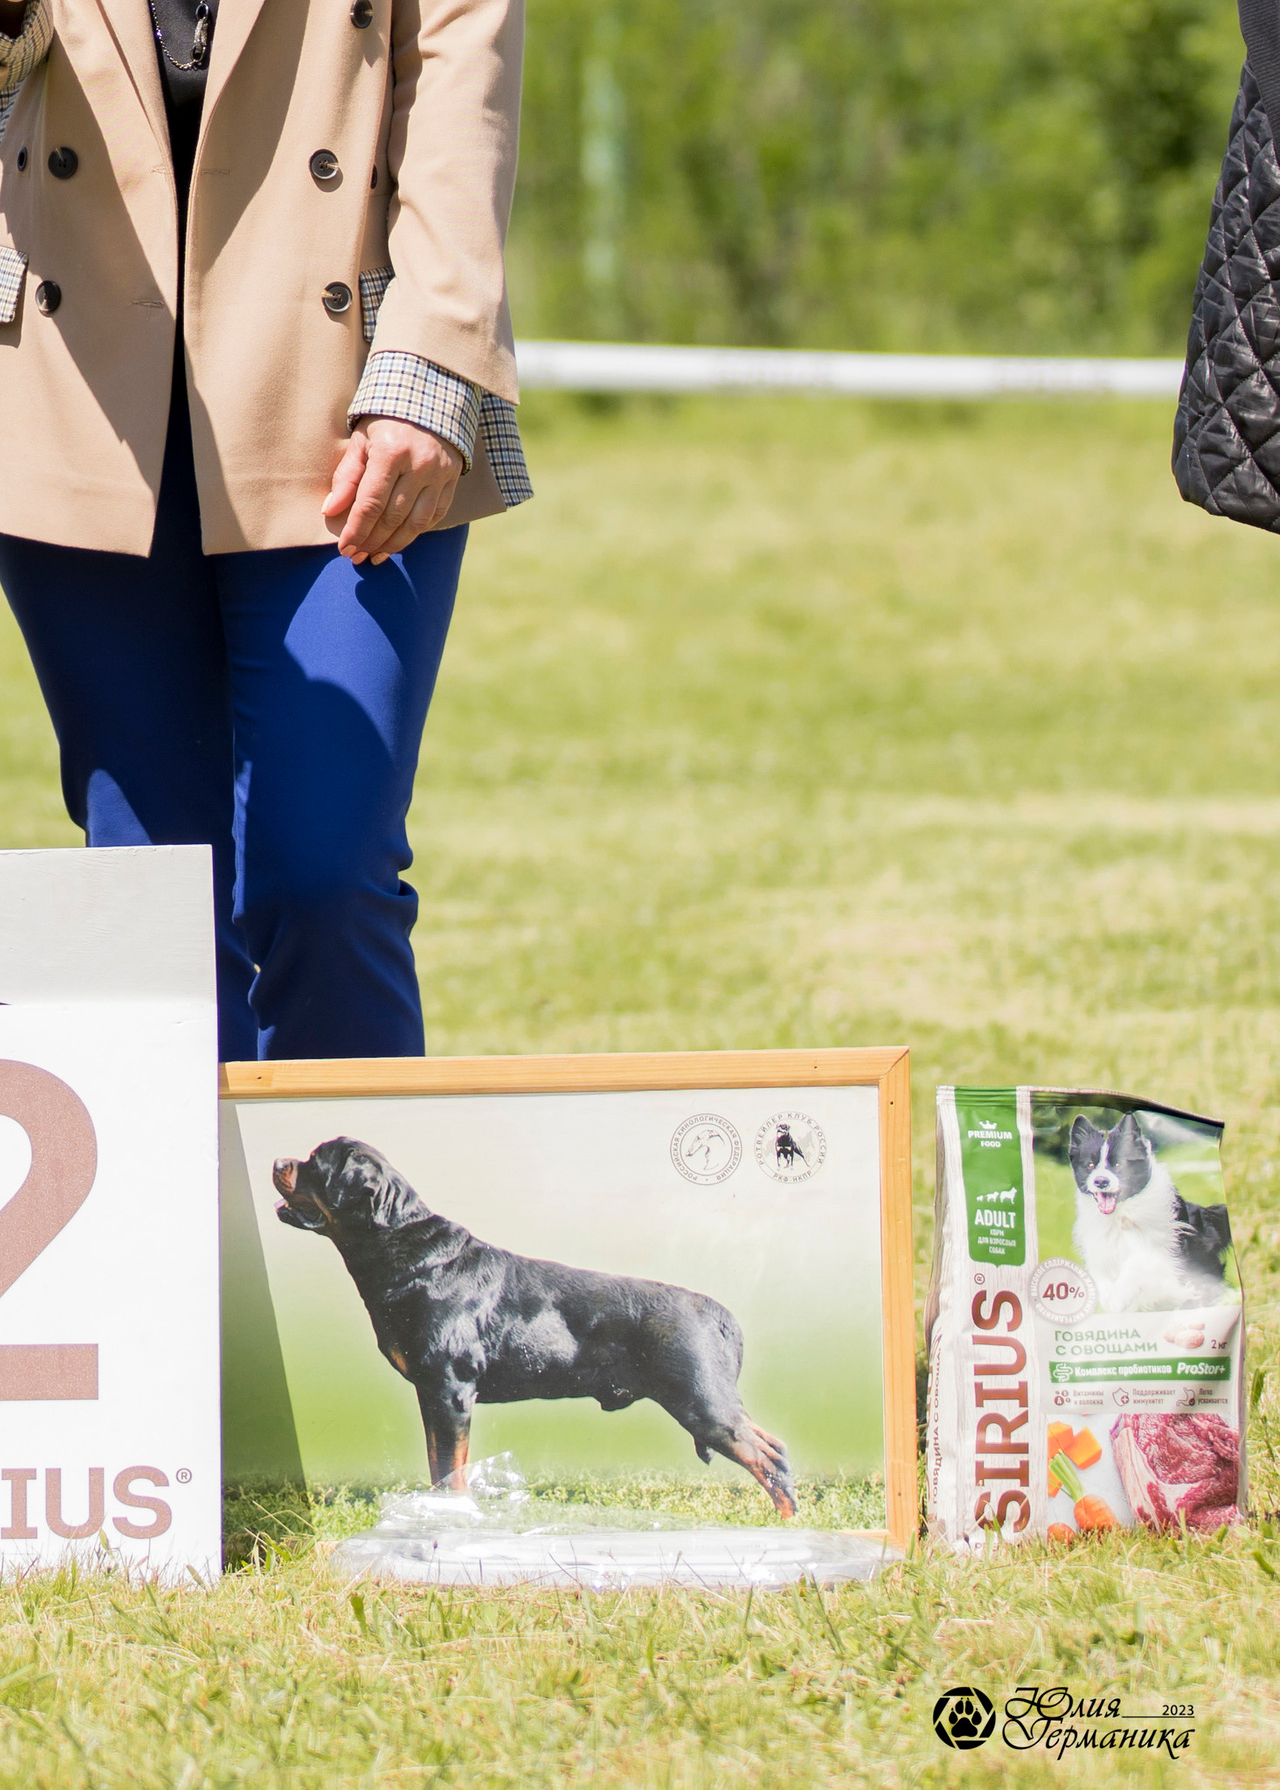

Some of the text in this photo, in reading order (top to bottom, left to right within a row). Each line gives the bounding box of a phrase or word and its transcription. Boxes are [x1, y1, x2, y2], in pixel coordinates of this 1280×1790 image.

[787, 1112, 813, 1126] КЛУБ
[967, 1130, 1013, 1140] PREMIUM
[673, 1114, 740, 1181] РОССИЙСКАЯ КИНОЛОГИЧЕСКАЯ ФЕДЕРАЦИЯ
[980, 1140, 1001, 1148] FOOD
[974, 1209, 1017, 1228] ADULT
[1042, 1282, 1085, 1300] 40%
[1054, 1328, 1141, 1342] ГОВЯДИНА
[1055, 1342, 1158, 1356] С ОВОЩАМИ
[1211, 1339, 1217, 1349] 2
[1074, 1362, 1227, 1377] Комплекс пробиотиков ProStor+
